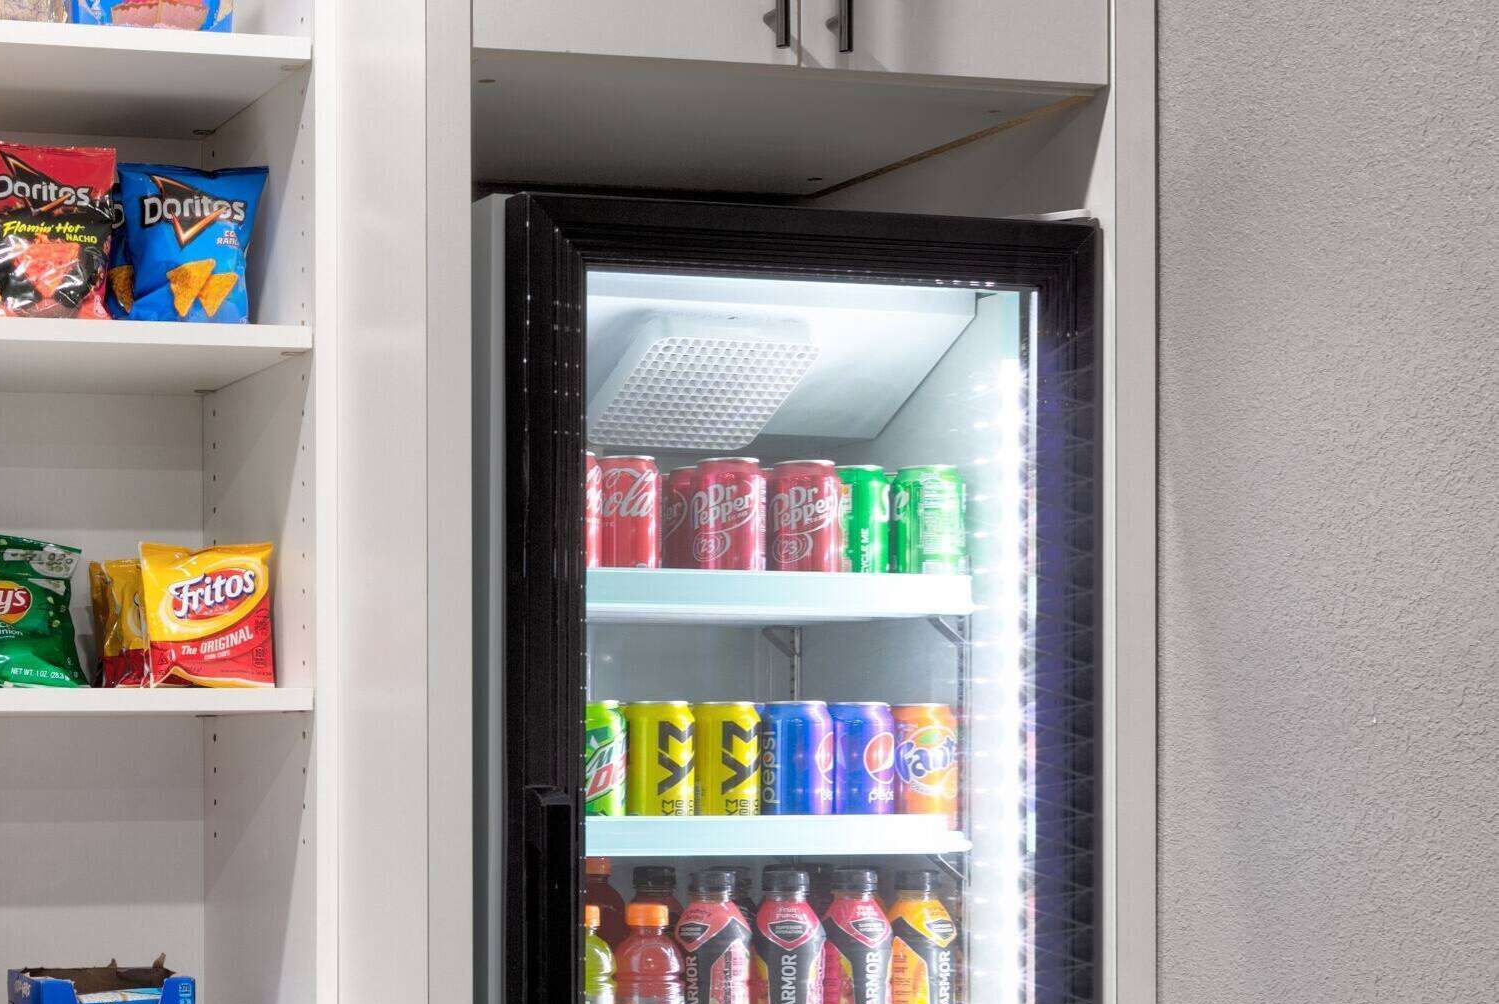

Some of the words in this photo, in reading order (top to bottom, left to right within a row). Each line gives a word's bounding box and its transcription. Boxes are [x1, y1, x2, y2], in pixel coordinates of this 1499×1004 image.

[144, 196, 248, 226] Doritos
[55, 221, 86, 234] Hot
[65, 234, 98, 244] NACHO
[601, 469, 656, 517] ola
[707, 484, 738, 508] Dr
[789, 486, 819, 508] Dr
[692, 490, 752, 531] Pepper
[168, 570, 255, 618] Fritos
[182, 645, 198, 656] The
[200, 625, 254, 654] ORIGINAL
[10, 667, 23, 675] NET
[763, 731, 781, 804] pepsi
